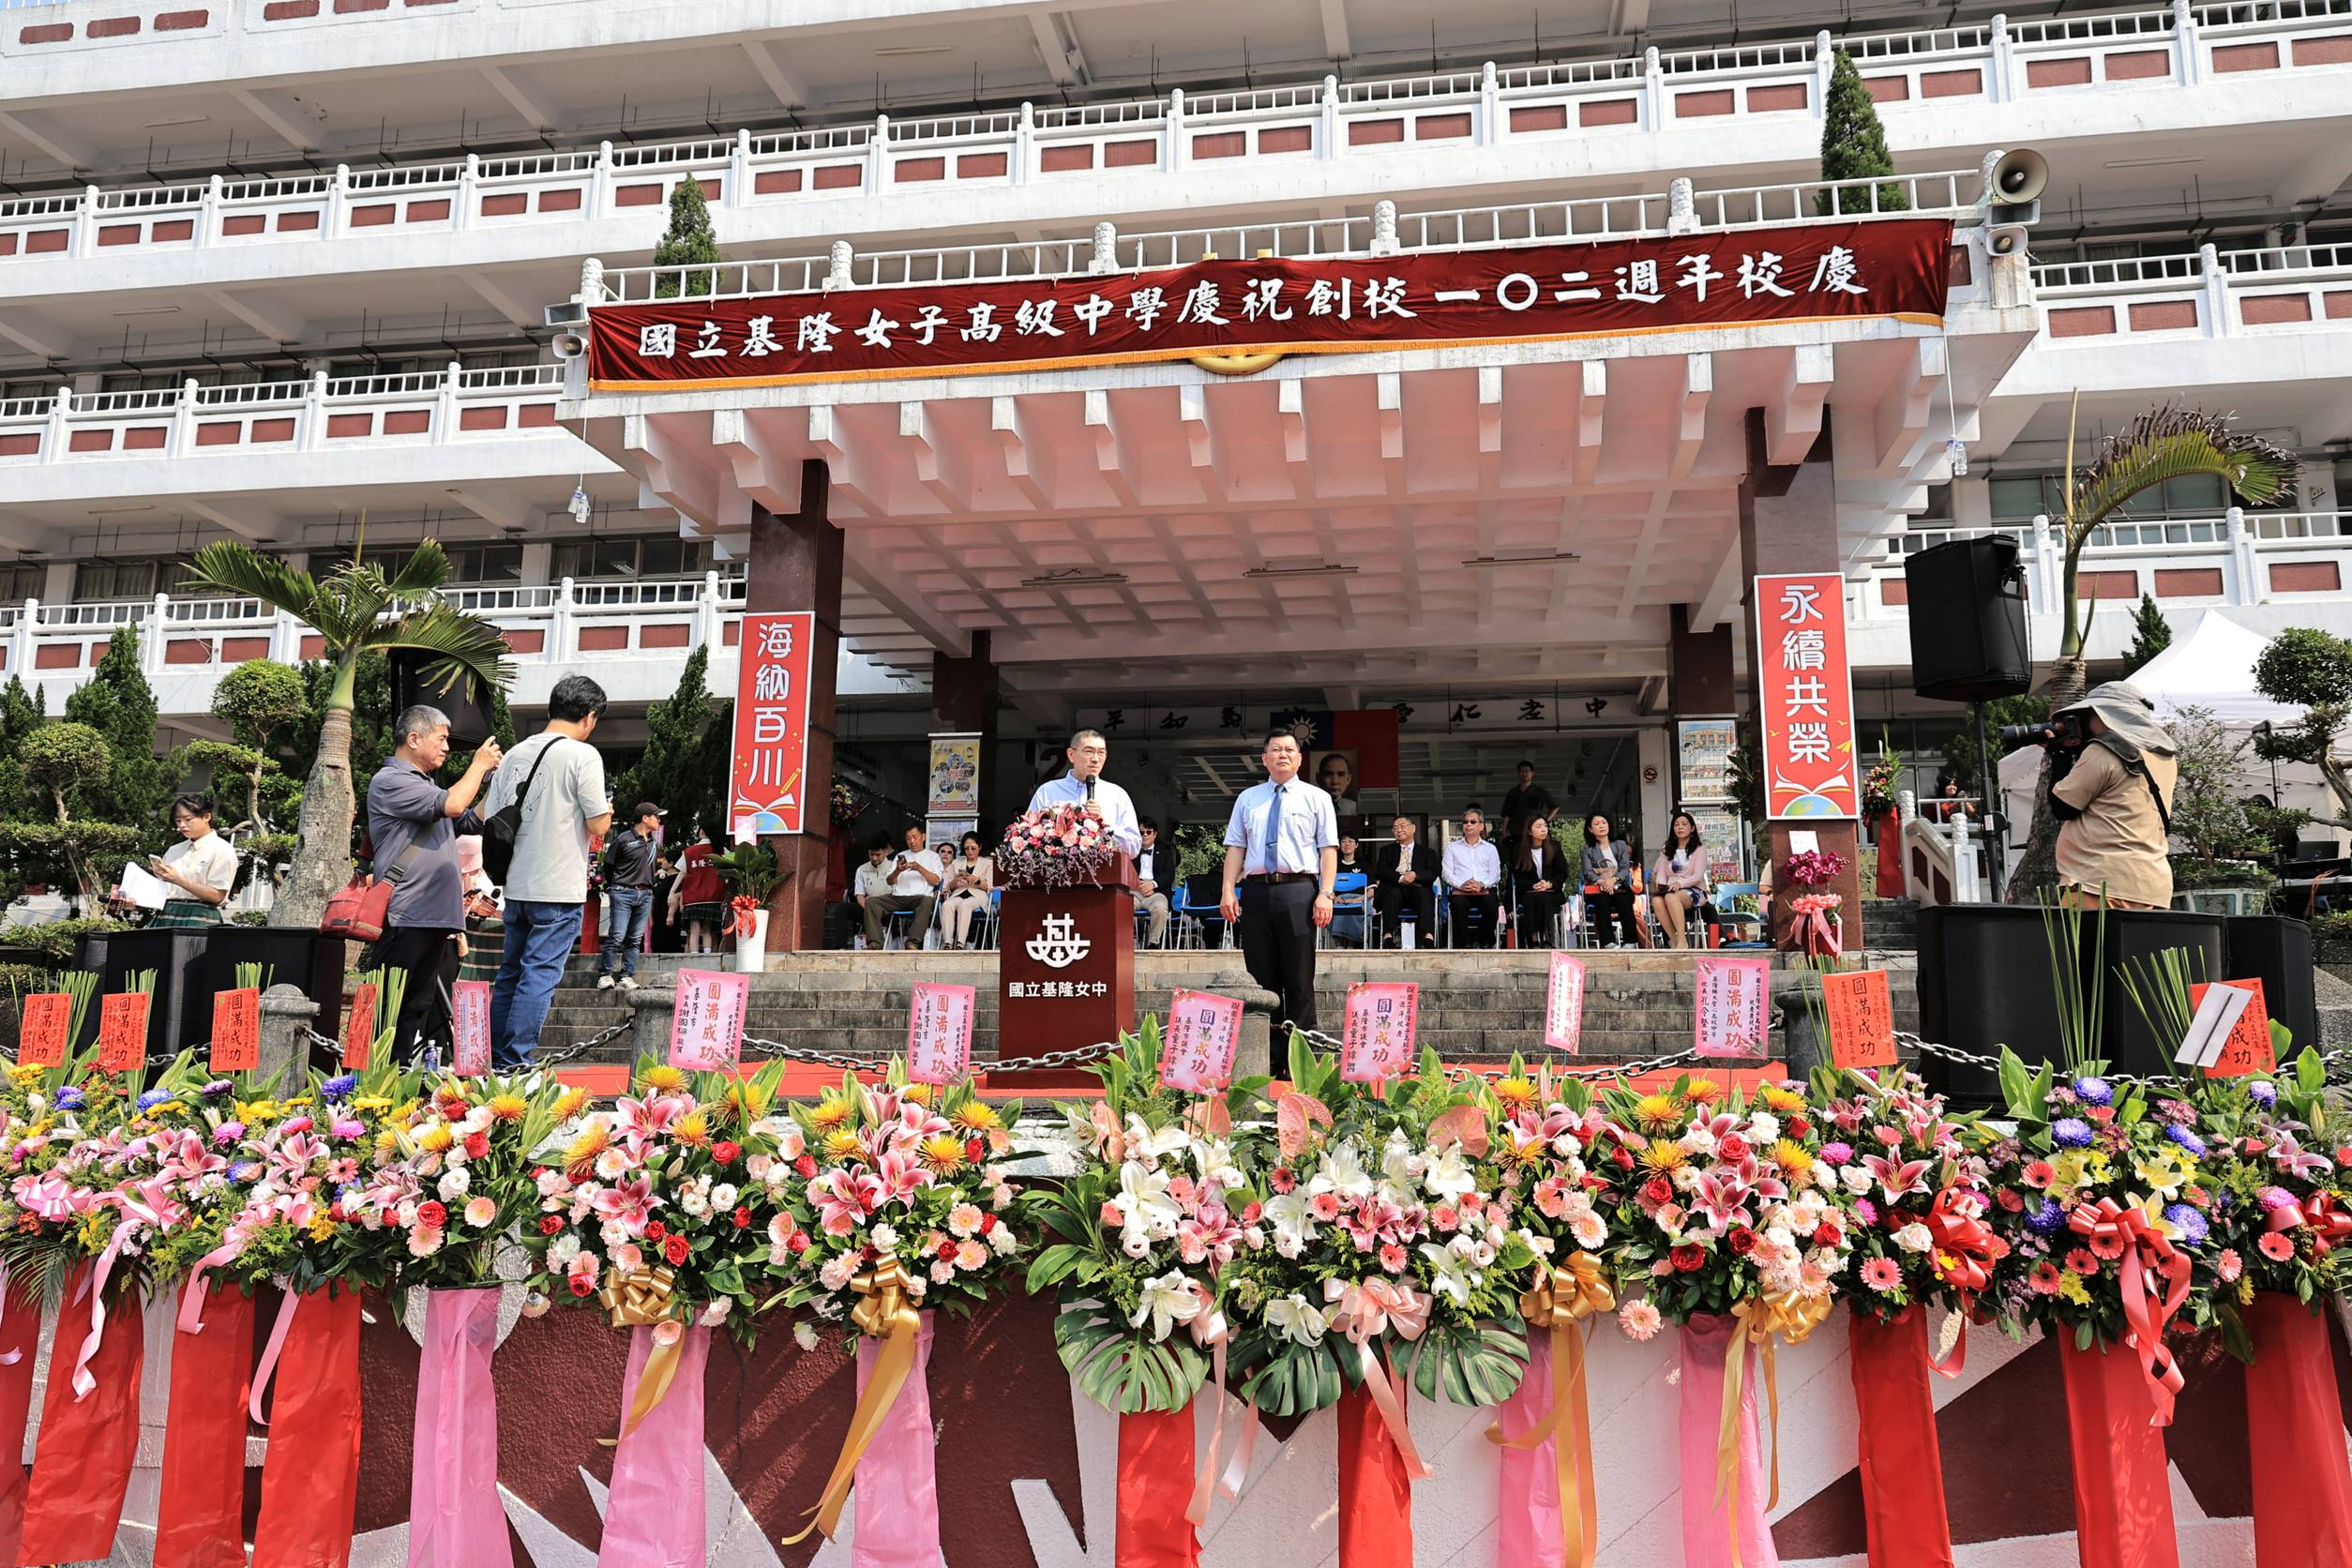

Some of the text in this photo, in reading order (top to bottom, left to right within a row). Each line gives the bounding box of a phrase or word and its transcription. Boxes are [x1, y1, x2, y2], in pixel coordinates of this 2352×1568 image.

[748, 621, 794, 787] 海納百川
[1780, 584, 1832, 764] 永續共榮
[699, 982, 721, 1062] 圓滿成功
[1009, 981, 1108, 998] 國立基隆女中
[1726, 968, 1742, 1048] 圓滿成功
[1852, 976, 1876, 1056] 圓滿成功
[35, 997, 53, 1060] 圓滿成功
[113, 997, 131, 1063] 圓滿成功
[229, 994, 243, 1063] 圓滿成功
[931, 994, 949, 1075] 圓滿成功
[1191, 1009, 1216, 1074] 圓滿成功
[1372, 998, 1393, 1063] 圓滿成功
